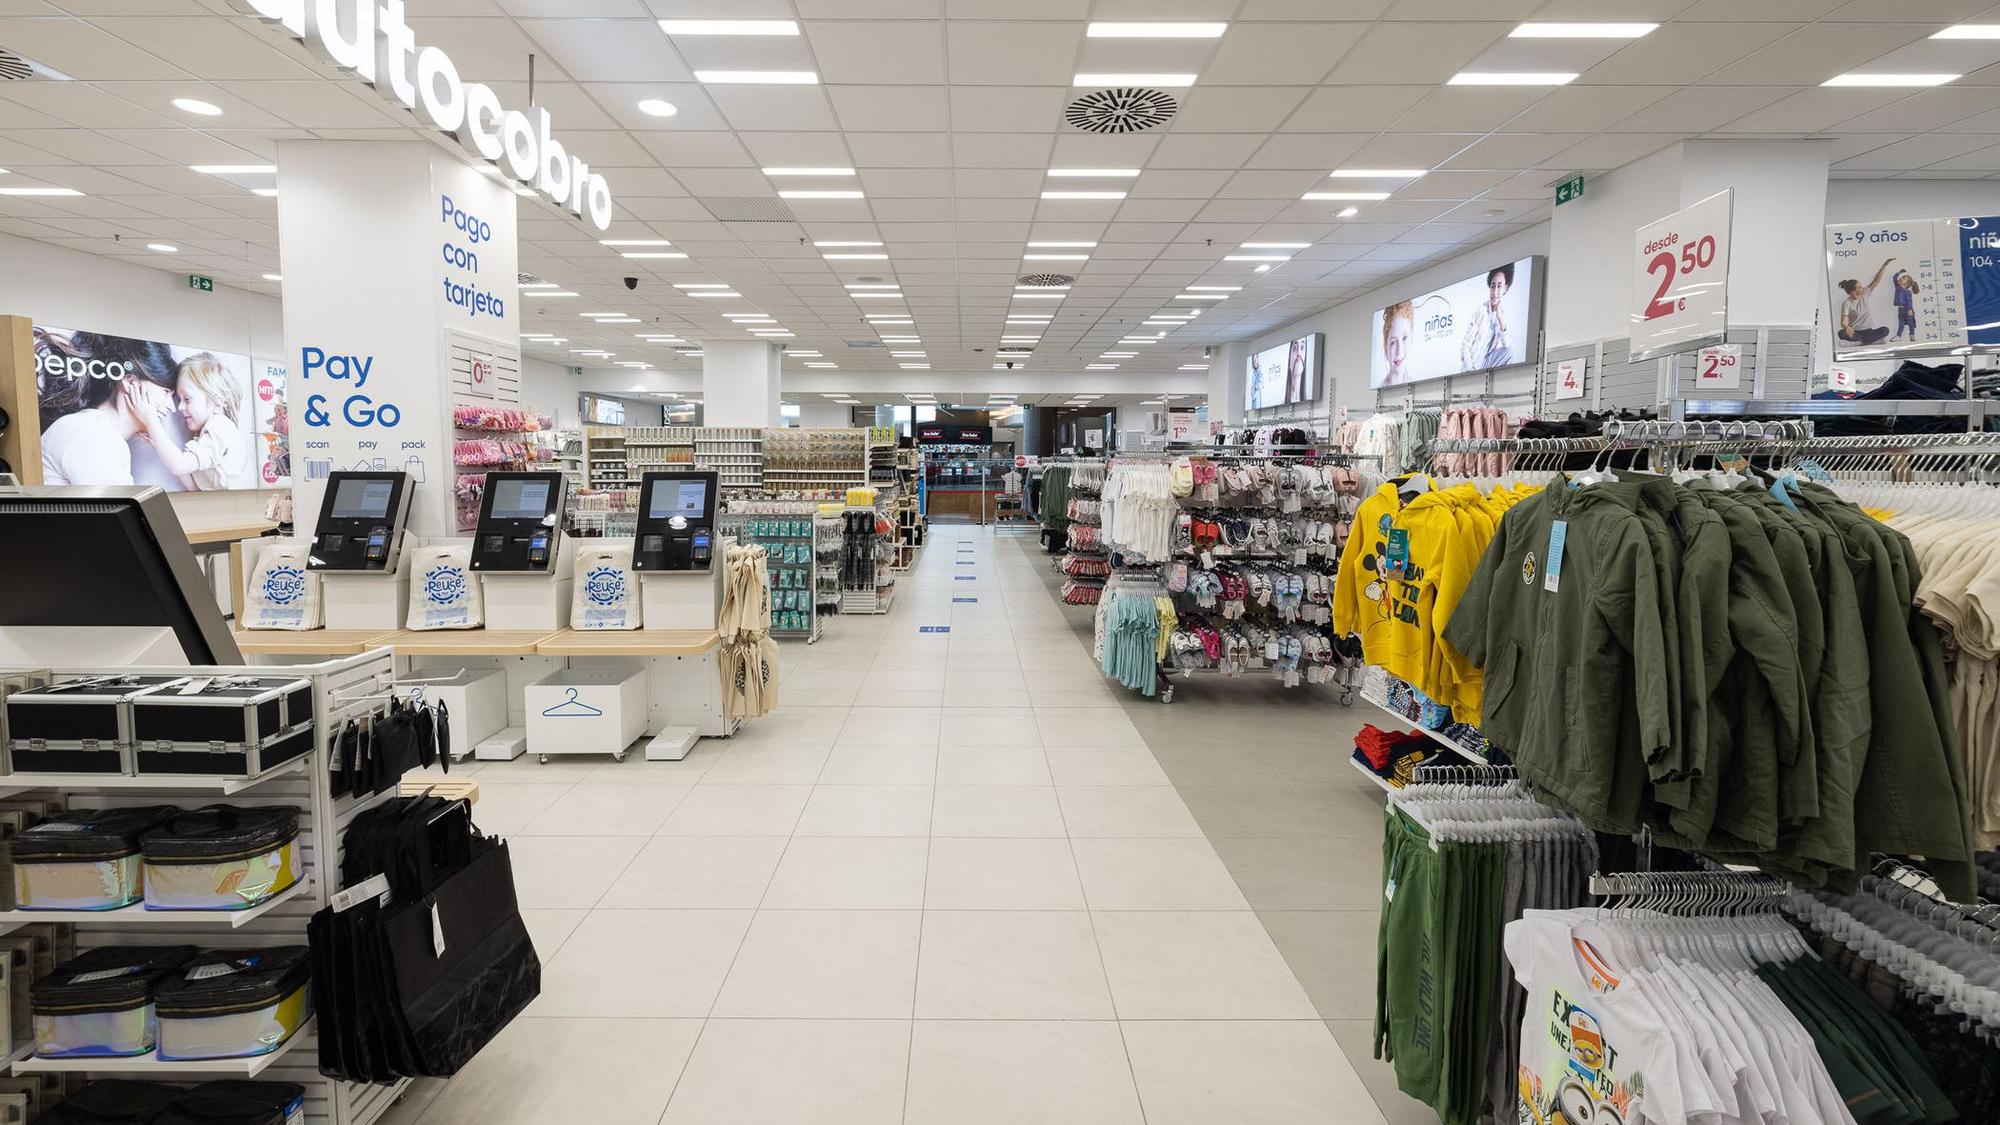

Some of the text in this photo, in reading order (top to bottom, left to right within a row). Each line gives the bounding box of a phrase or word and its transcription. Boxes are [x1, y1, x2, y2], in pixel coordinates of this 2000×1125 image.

[441, 194, 491, 244] Pago
[1643, 232, 1679, 255] desde
[1870, 230, 1908, 243] años
[1969, 232, 2000, 249] niñ
[443, 241, 478, 273] con
[1835, 249, 1857, 258] ropa
[1969, 255, 1993, 268] 104
[443, 277, 504, 318] tarjeta
[1424, 314, 1453, 333] niñas
[302, 347, 373, 388] Pay
[304, 394, 400, 428] & Go
[305, 439, 426, 451] scan pay pack
[266, 579, 301, 594] Reuse
[428, 578, 462, 593] Reuse
[588, 580, 621, 595] Reuse
[1419, 969, 1433, 1016] WILD
[1417, 1017, 1432, 1056] ONE
